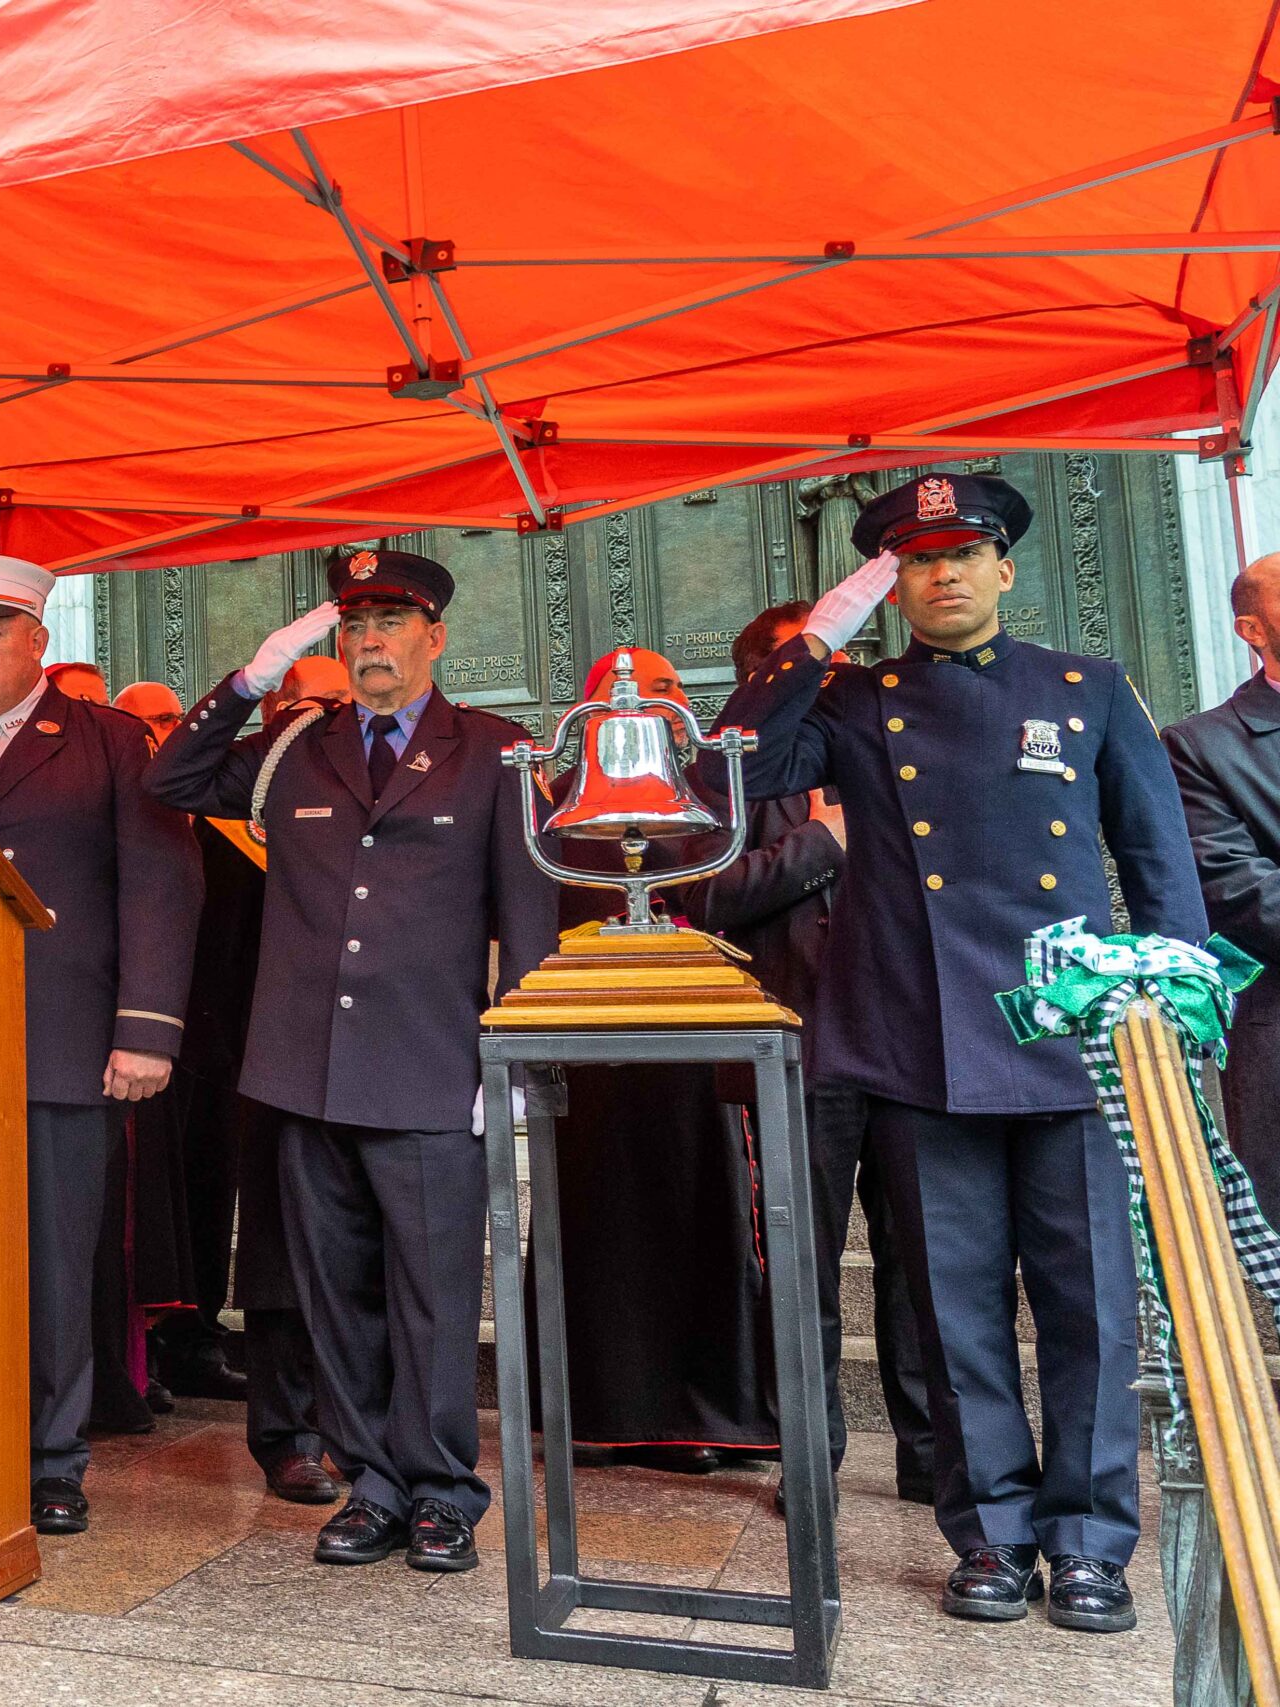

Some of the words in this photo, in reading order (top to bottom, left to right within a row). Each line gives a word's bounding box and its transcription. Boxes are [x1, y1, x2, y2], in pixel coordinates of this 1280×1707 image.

[997, 608, 1016, 622] ER
[1019, 607, 1040, 621] OF
[1004, 622, 1044, 637] GRANT
[665, 634, 681, 647] ST
[683, 645, 733, 660] CABRIN
[446, 658, 477, 672] FIRST
[483, 654, 523, 669] PRIEST
[461, 670, 487, 685] NEW
[492, 667, 526, 682] YORK
[1030, 742, 1057, 754] 5727
